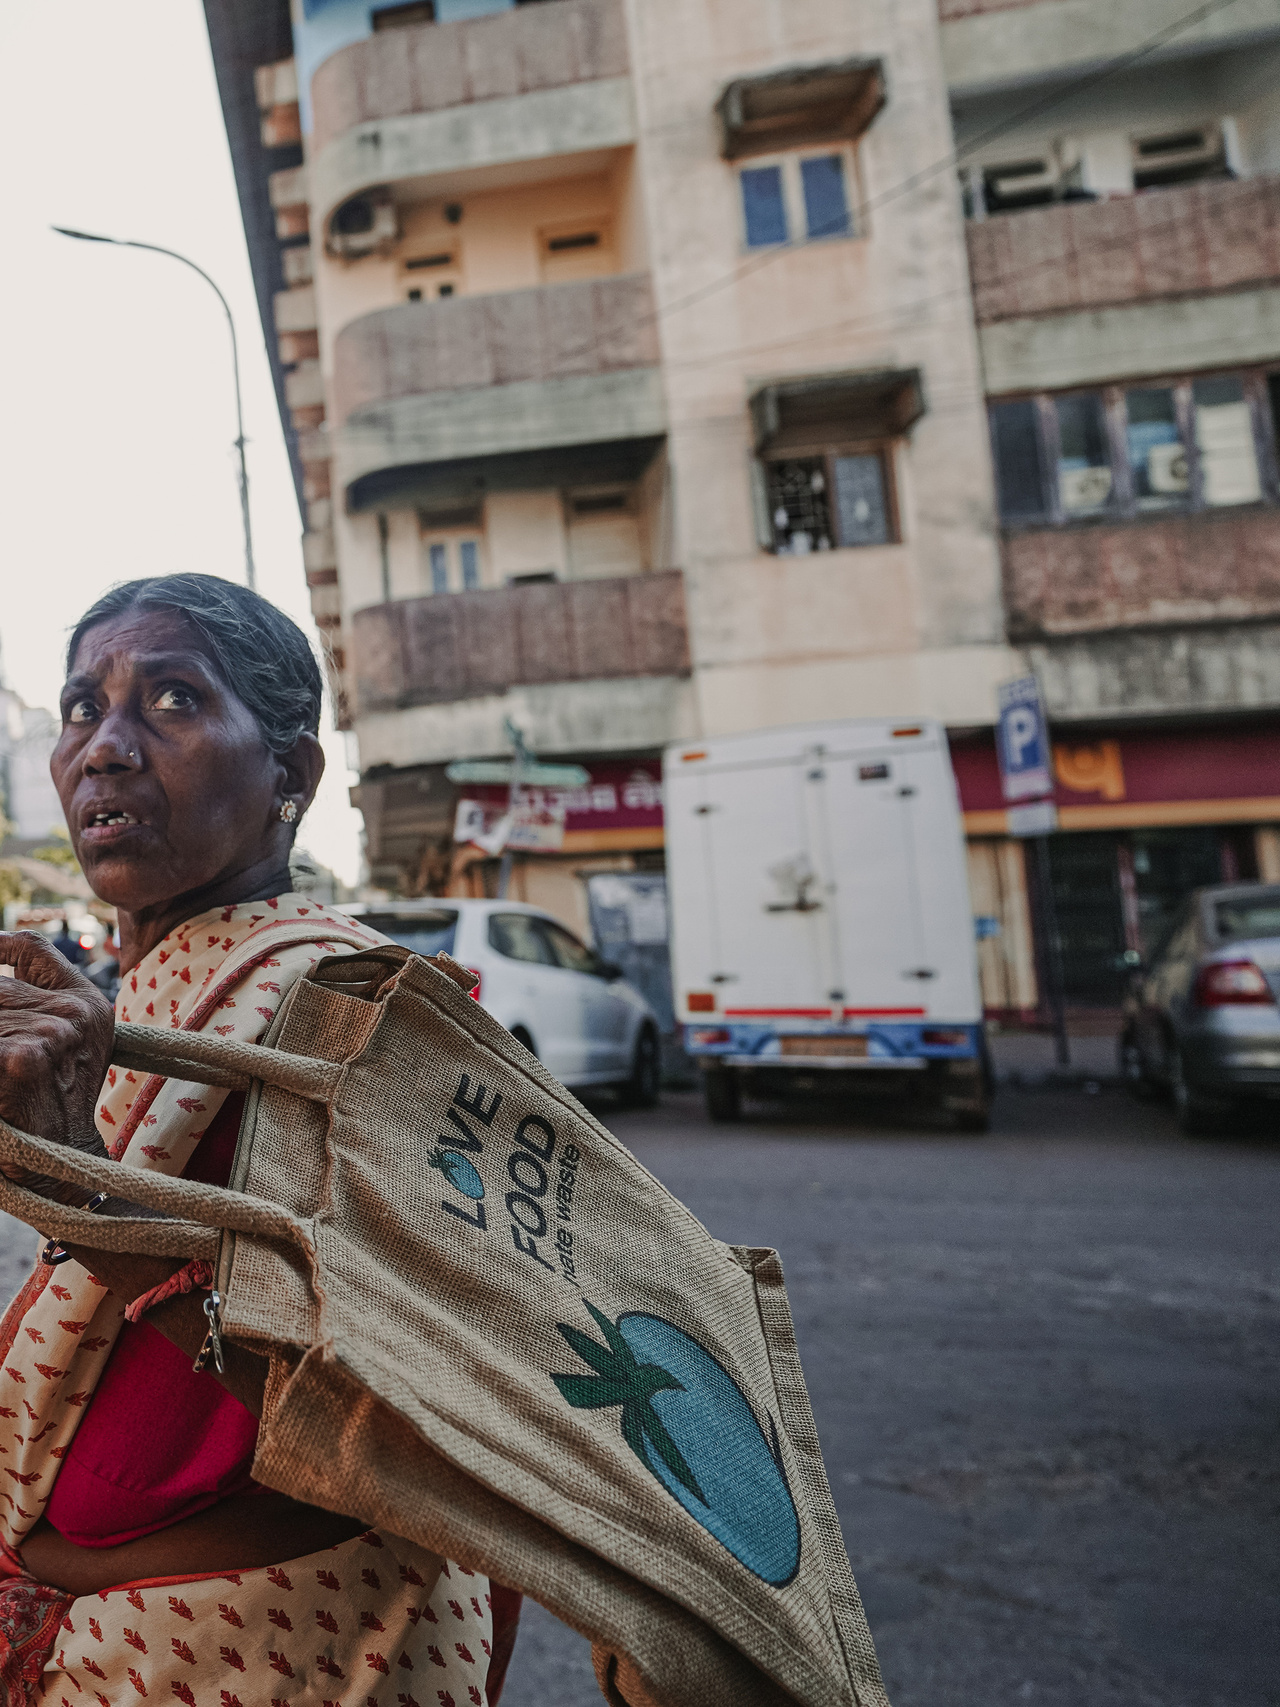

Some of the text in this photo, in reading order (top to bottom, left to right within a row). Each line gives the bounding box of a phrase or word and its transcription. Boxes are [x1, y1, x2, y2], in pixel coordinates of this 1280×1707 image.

[1006, 706, 1038, 766] P
[506, 1114, 556, 1272] FOOD
[556, 1144, 581, 1221] waste
